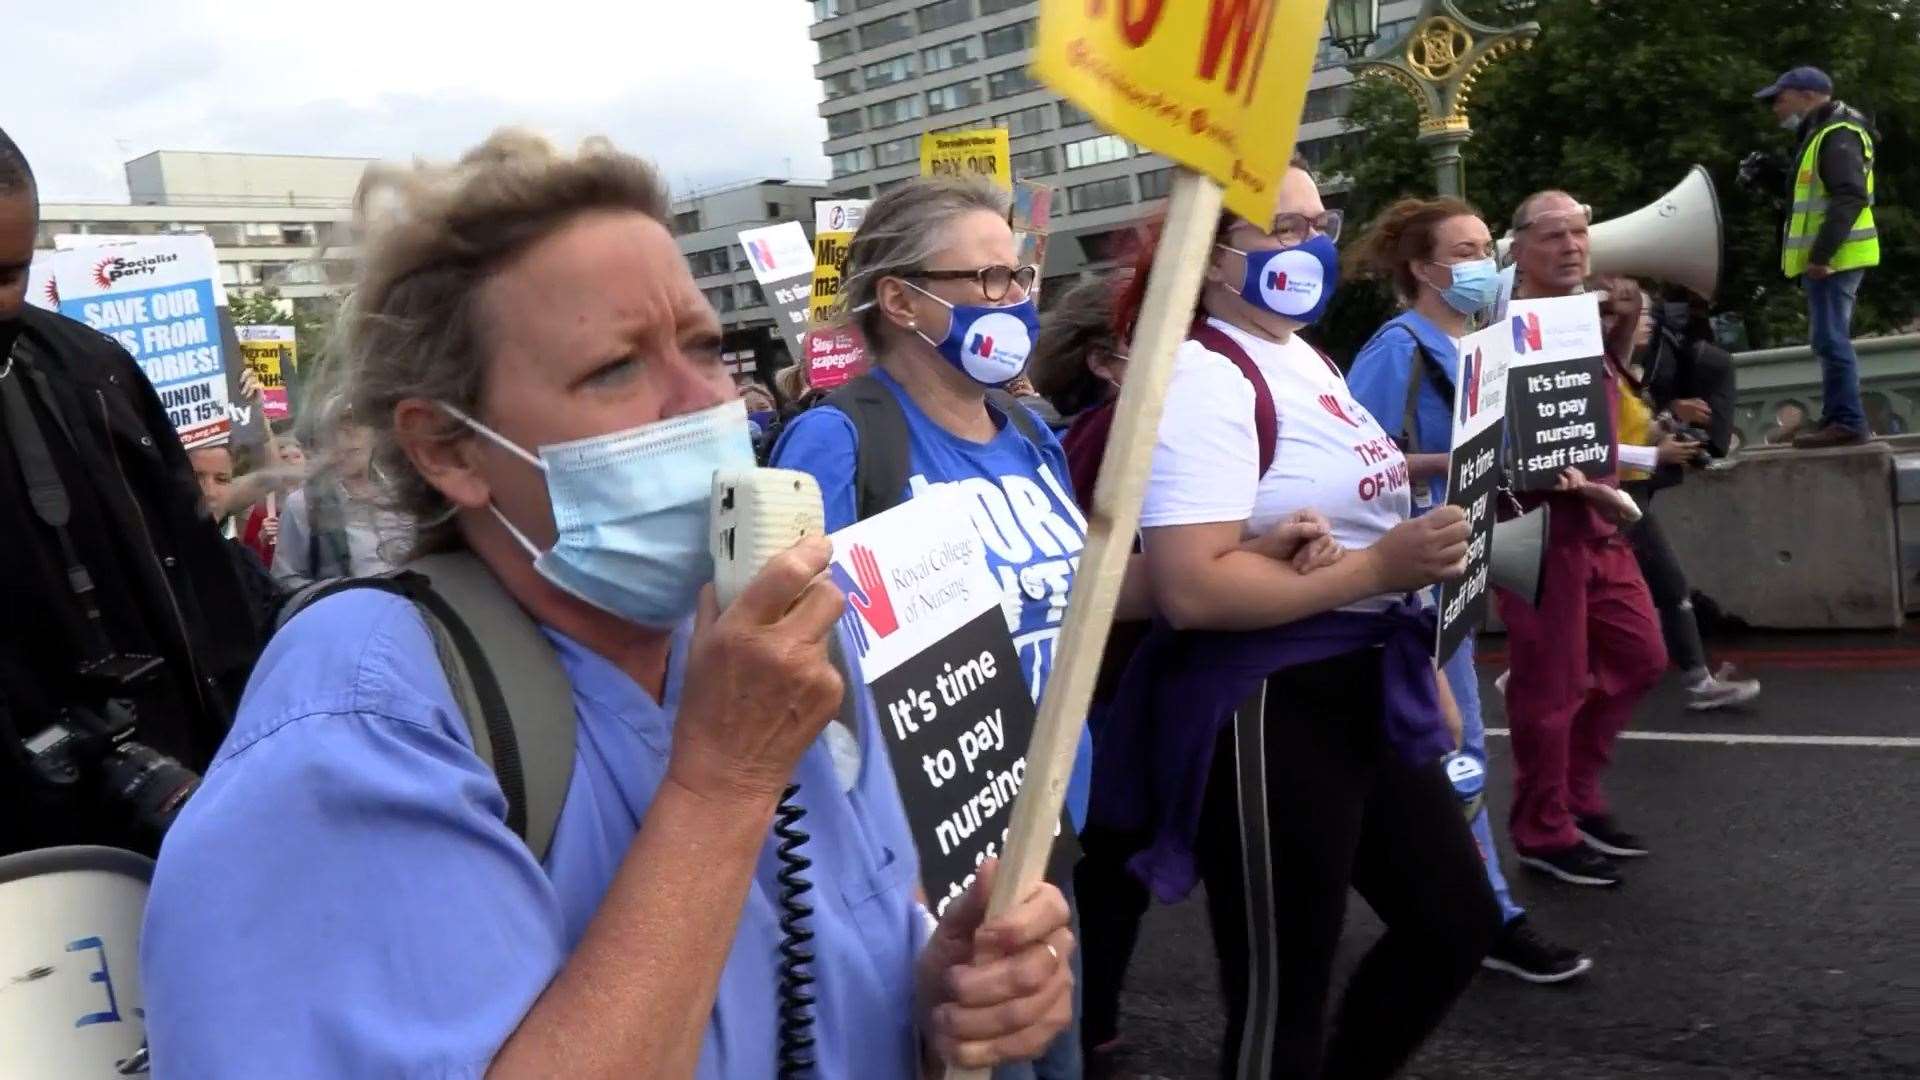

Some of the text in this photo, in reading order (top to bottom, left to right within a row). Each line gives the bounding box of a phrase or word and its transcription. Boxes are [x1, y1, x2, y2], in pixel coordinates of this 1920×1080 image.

[113, 253, 178, 271] Socialist
[83, 288, 199, 330] SAVE OUR
[142, 317, 208, 352] FROM
[161, 382, 211, 409] UNION
[1528, 373, 1552, 394] It's
[1554, 370, 1592, 390] time
[170, 400, 224, 428] OR 15%
[1537, 397, 1588, 419] to pay
[1536, 421, 1596, 444] nursing
[1354, 438, 1388, 467] THE
[1528, 443, 1609, 472] staff fairly
[1459, 447, 1495, 491] It's time
[1359, 472, 1386, 501] OF
[888, 688, 937, 740] It's
[936, 651, 997, 706] time
[922, 708, 1005, 788] to pay
